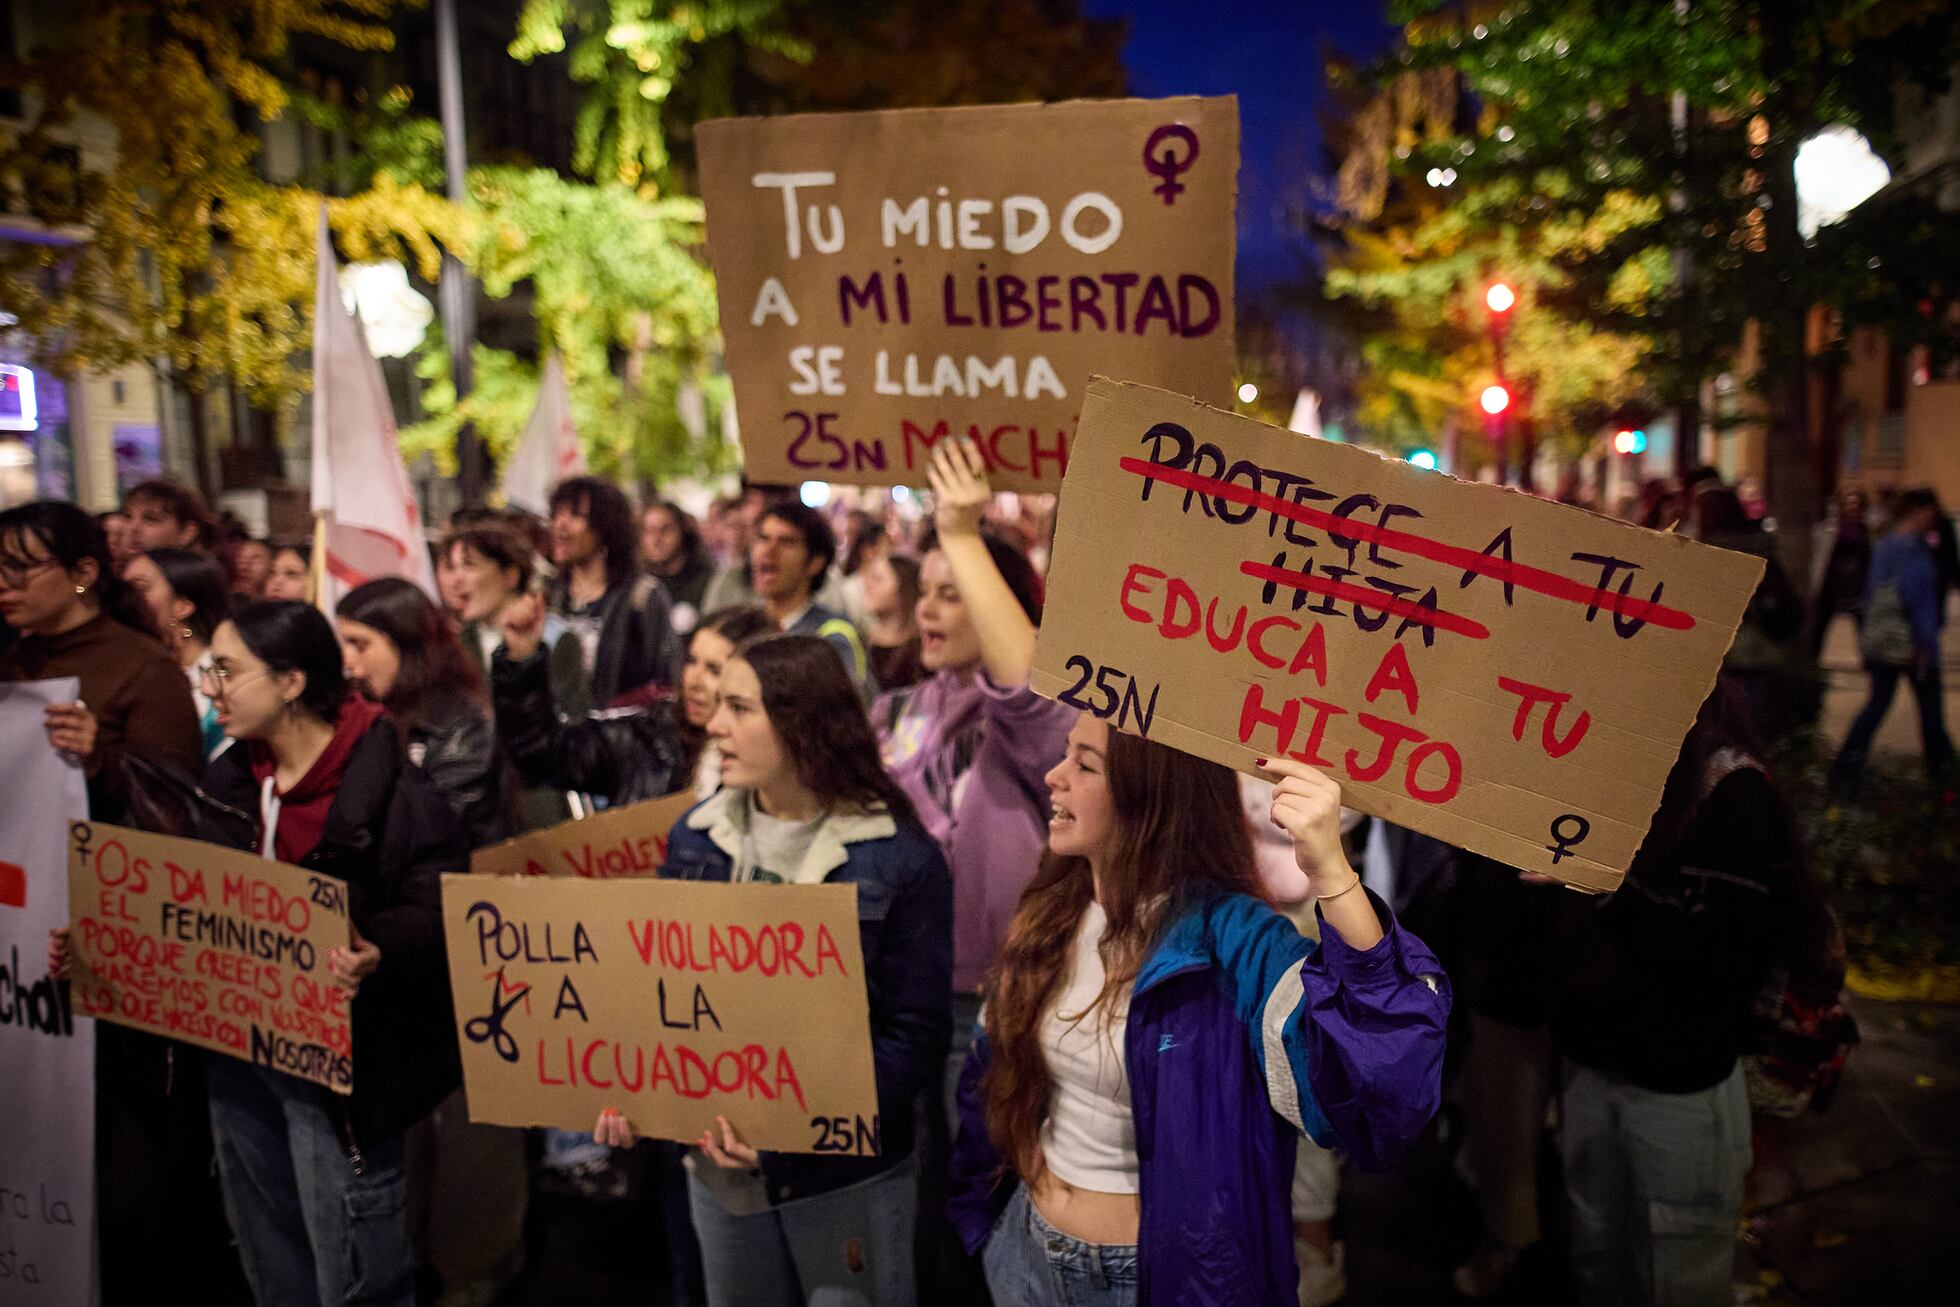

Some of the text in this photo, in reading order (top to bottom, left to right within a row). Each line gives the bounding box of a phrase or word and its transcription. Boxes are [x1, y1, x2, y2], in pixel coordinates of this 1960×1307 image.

[750, 278, 798, 326] A
[789, 346, 1067, 399] SE LLAMA
[900, 415, 1079, 479] MACH
[1140, 421, 1664, 639] PROTEGE A TU
[1262, 551, 1439, 648] HIJA
[1056, 655, 1161, 739] 25N
[1119, 563, 1592, 759] EDUCA A TU
[1238, 683, 1463, 804] HIJO
[100, 891, 316, 972] EL FEMINISMO
[163, 861, 208, 904] DA
[222, 871, 311, 933] MIEDO
[308, 877, 346, 917] 25N
[78, 917, 347, 1018] PORQUE CREEIS QUE
[466, 901, 849, 979] POLLA VIOLADORA
[81, 983, 114, 1014] LO
[251, 1023, 353, 1087] NOSOTRAS
[218, 988, 263, 1022] CON
[554, 974, 723, 1032] A LA
[538, 1035, 809, 1114] LICUADORA
[811, 1114, 881, 1156] 25N
[40, 1183, 76, 1228] la
